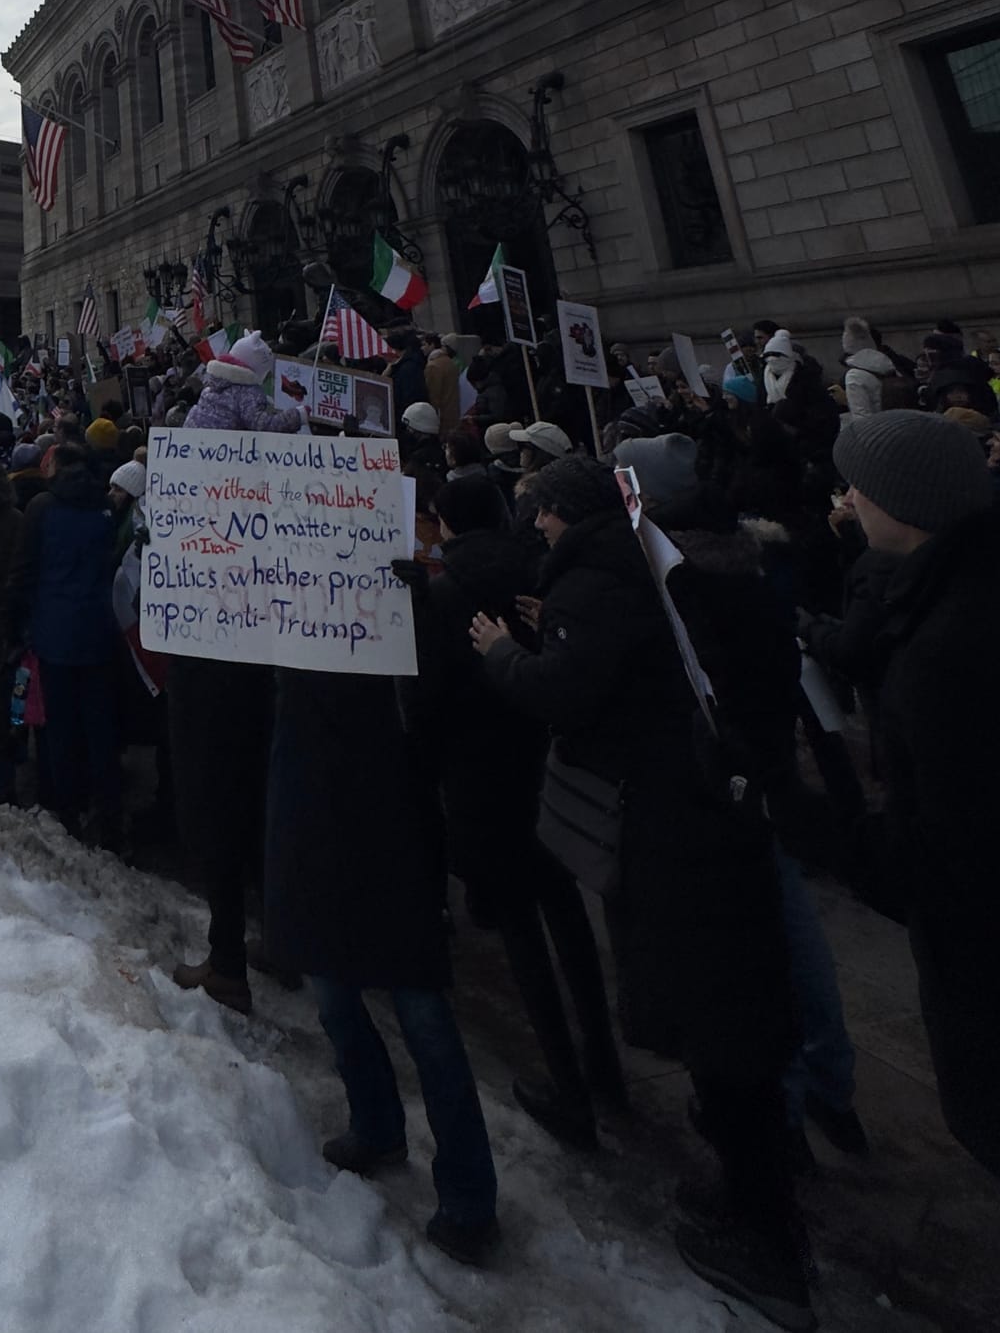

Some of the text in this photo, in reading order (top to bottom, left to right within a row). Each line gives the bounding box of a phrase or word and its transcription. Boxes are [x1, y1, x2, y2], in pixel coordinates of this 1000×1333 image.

[317, 369, 349, 385] FREE
[317, 405, 348, 420] IRAN
[153, 430, 191, 459] The
[198, 436, 258, 464] world
[265, 442, 326, 469] would
[330, 443, 358, 472] be
[203, 477, 273, 505] without
[277, 477, 303, 502] the
[180, 537, 237, 555] in Iran
[225, 511, 269, 541] NO
[274, 515, 342, 538] matter
[335, 526, 401, 560] your
[228, 554, 323, 588] whether
